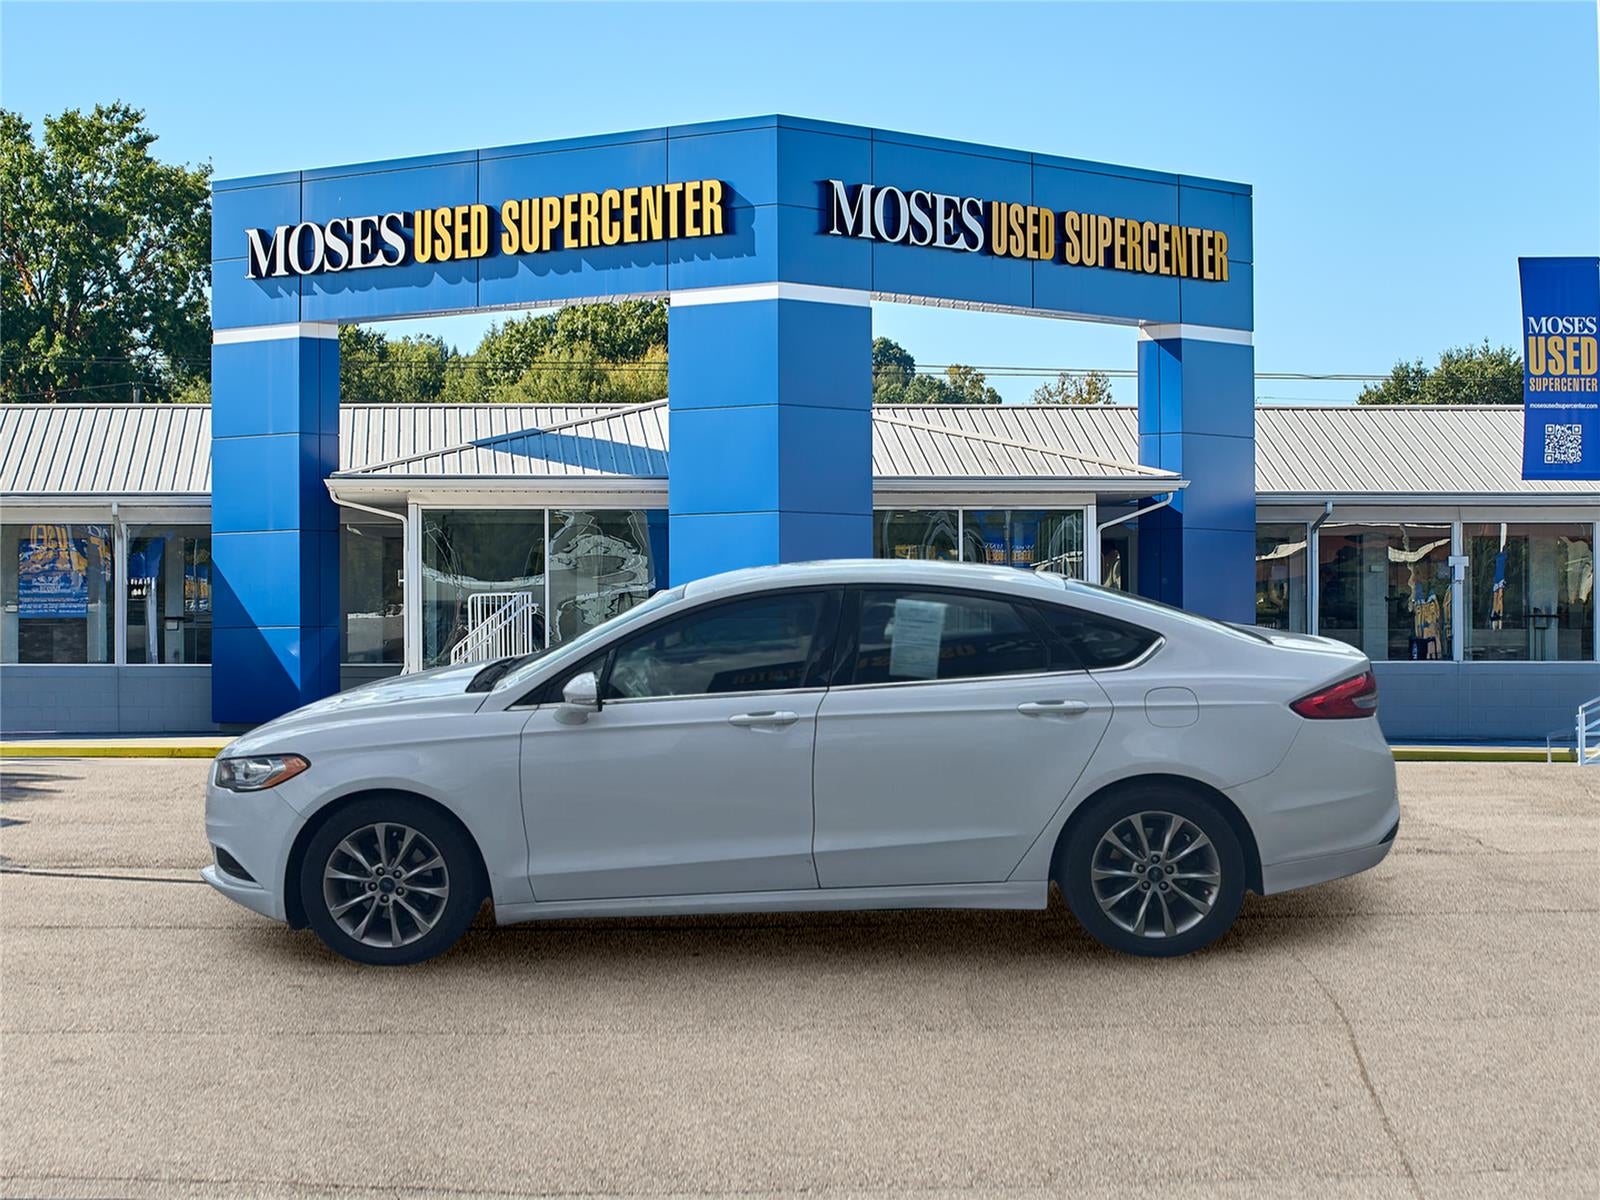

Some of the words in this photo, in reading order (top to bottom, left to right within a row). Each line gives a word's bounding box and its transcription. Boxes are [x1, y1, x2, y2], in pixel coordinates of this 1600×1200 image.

[244, 212, 406, 279] MOSES
[413, 203, 488, 264] USED
[501, 179, 723, 255] SUPERCENTER
[829, 179, 984, 252] MOSES
[991, 201, 1055, 260] USED
[1065, 210, 1229, 281] SUPERCENTER
[1528, 316, 1597, 334] MOSES
[1528, 336, 1598, 375] USED
[1529, 377, 1598, 392] SUPERCENTER
